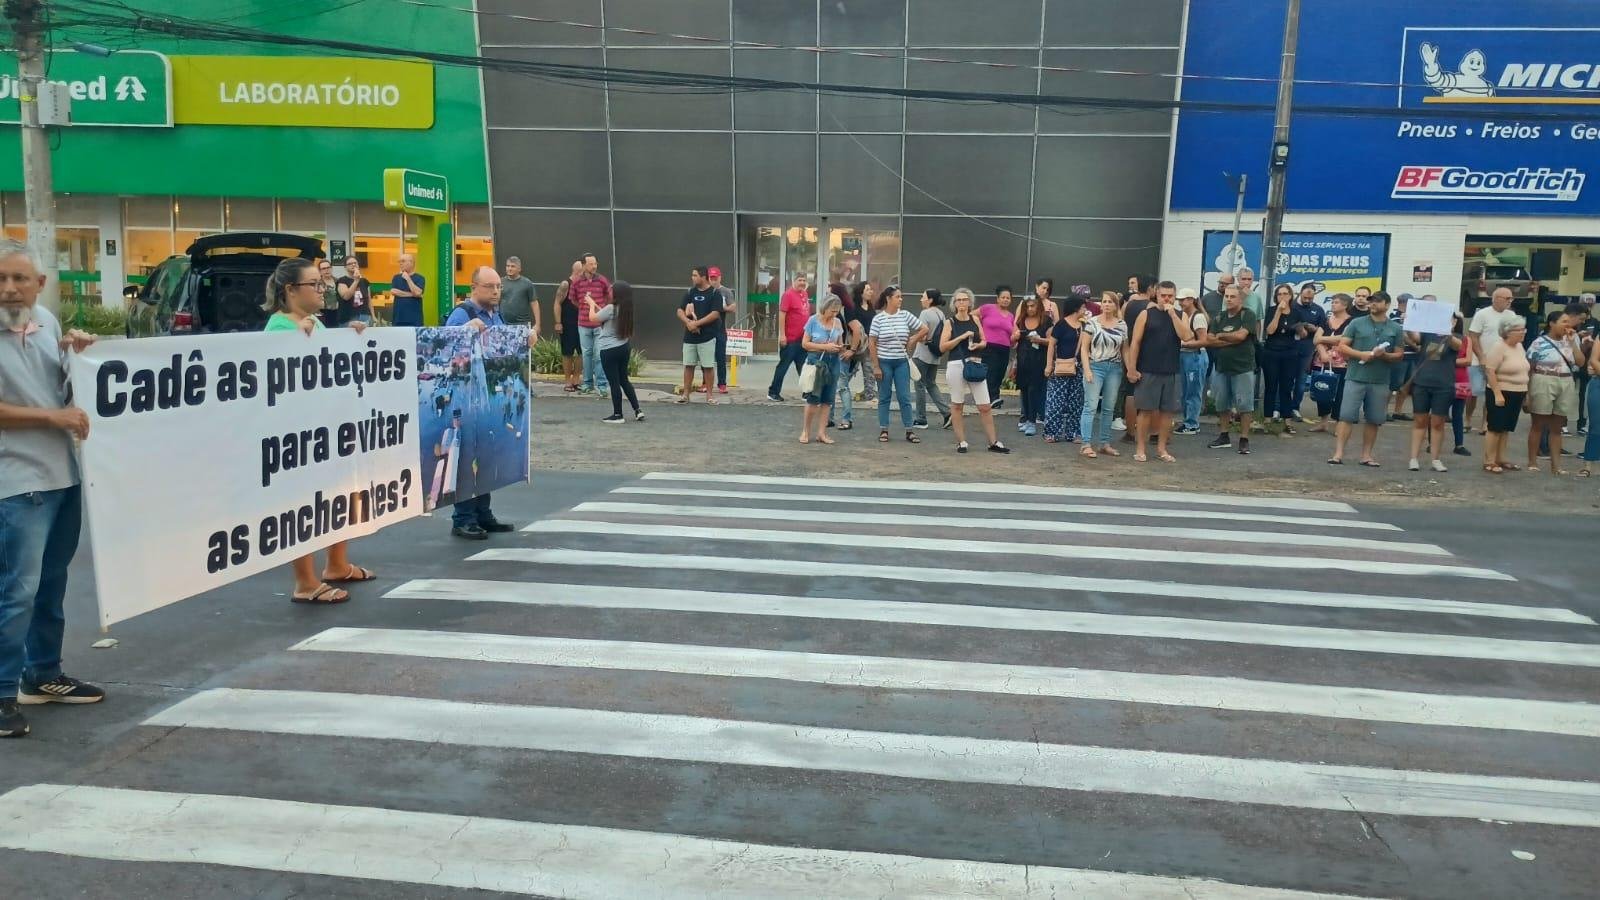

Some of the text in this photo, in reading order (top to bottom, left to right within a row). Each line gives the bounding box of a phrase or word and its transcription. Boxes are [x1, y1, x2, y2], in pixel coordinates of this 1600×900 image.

[219, 77, 399, 106] LABORATÓRIO
[1398, 121, 1600, 139] Pneus Freios Ge
[408, 183, 435, 199] Unimed
[1397, 168, 1582, 191] BFGoodrich
[1315, 242, 1356, 250] SERVIÇOS
[1322, 255, 1370, 267] PNEUS
[96, 340, 406, 418] Cadê as proteções
[261, 408, 409, 487] para evitar
[207, 468, 412, 574] as enchentes?
